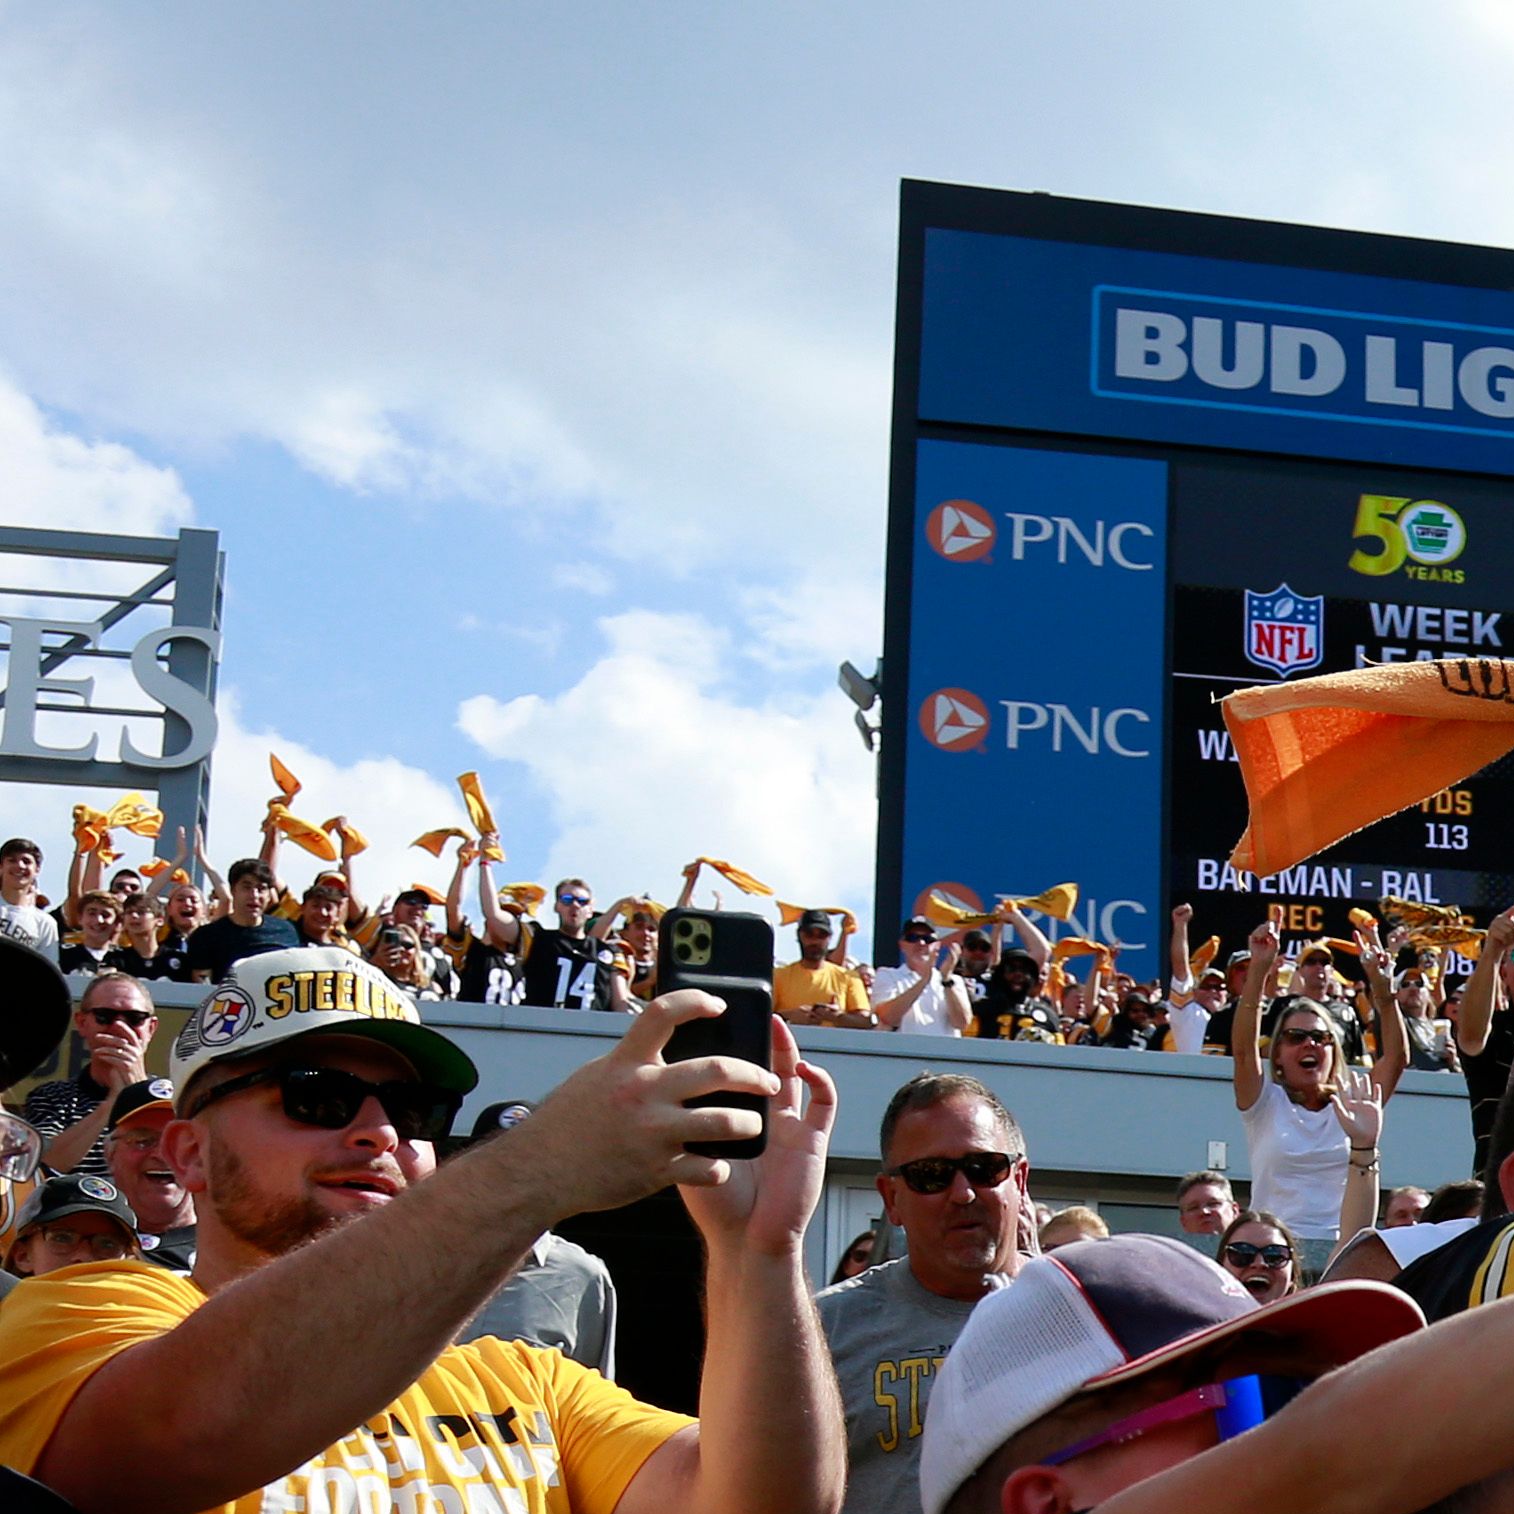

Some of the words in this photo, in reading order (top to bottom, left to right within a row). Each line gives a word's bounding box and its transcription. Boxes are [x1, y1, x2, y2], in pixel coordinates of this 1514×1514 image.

[1115, 308, 1347, 398] BUD
[1004, 512, 1155, 572] PNC
[1347, 493, 1468, 577] 50
[1404, 564, 1466, 585] YEARS
[1254, 623, 1315, 664] NFL
[1369, 602, 1502, 647] WEEK
[998, 699, 1151, 758] PNC
[1424, 822, 1470, 850] 113
[1380, 869, 1442, 905] BAL
[554, 956, 598, 1012] 14
